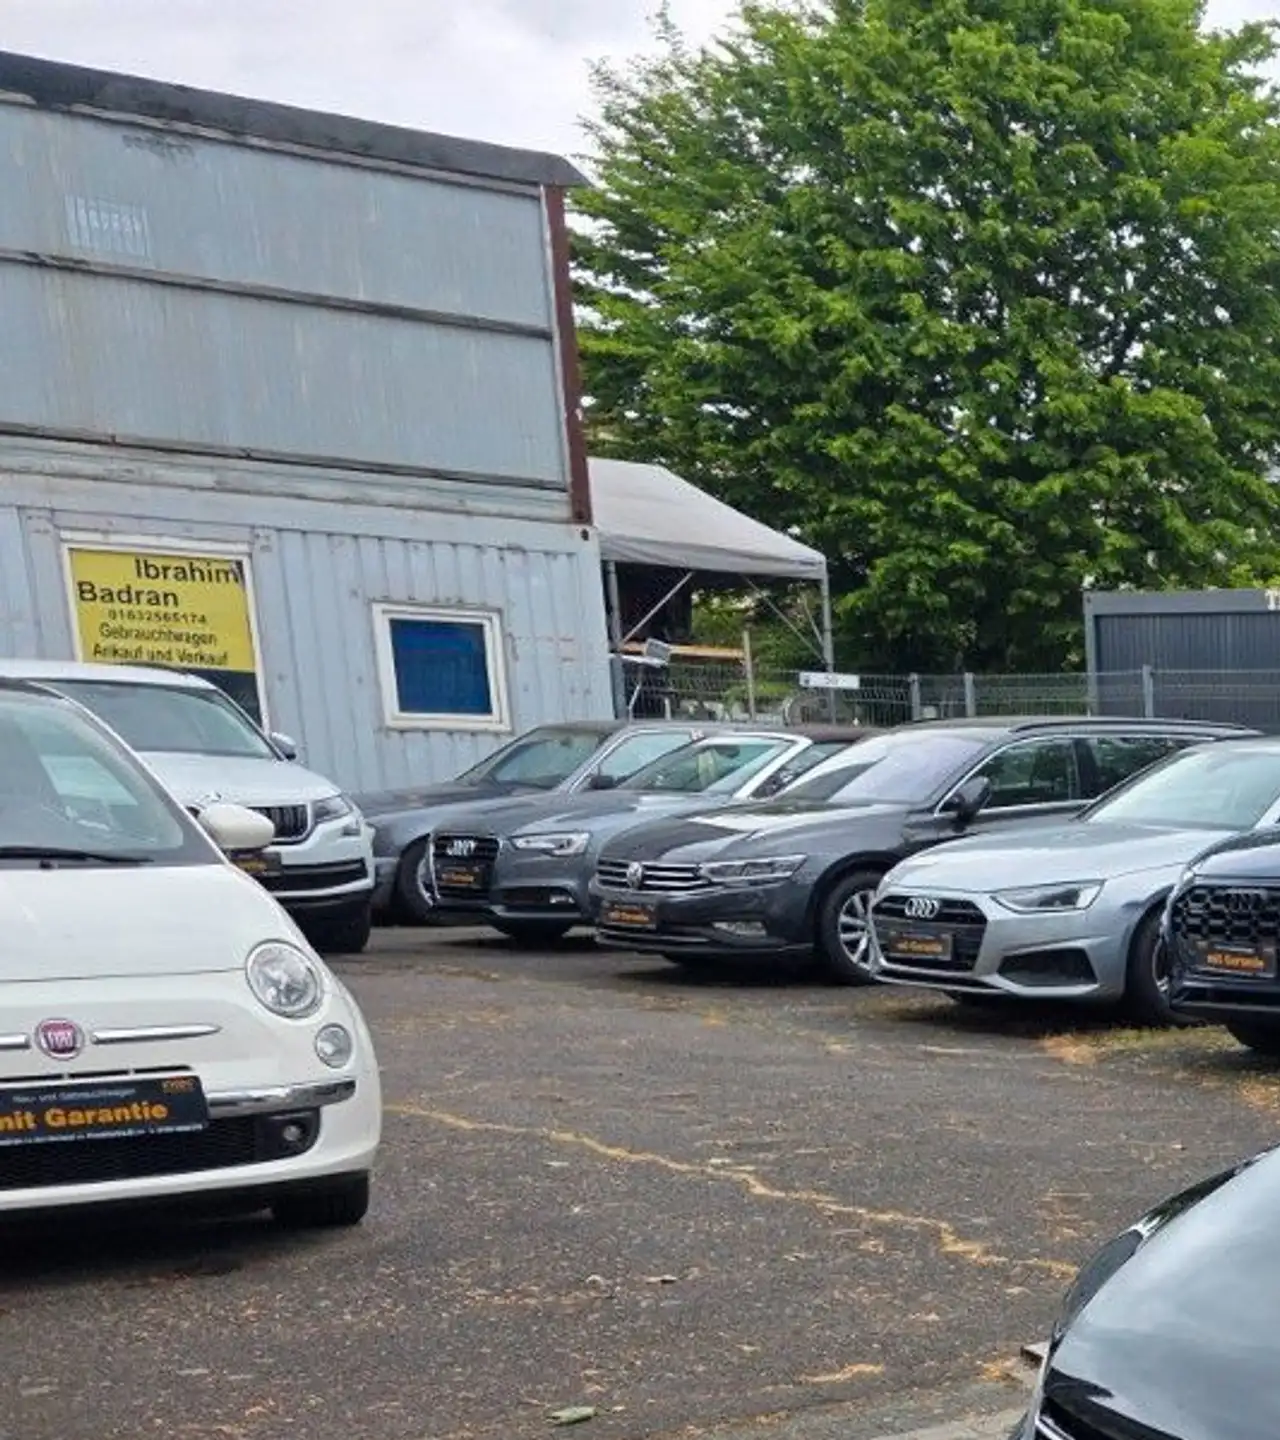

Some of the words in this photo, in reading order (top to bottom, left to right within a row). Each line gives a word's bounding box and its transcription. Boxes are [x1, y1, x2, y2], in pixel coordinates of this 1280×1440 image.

[135, 557, 242, 584] Ibrahim
[77, 581, 179, 607] Badran
[99, 622, 218, 646] Gebrauchtwagen
[93, 643, 143, 660] Ankauf
[147, 645, 173, 662] und
[174, 649, 229, 666] Verkauf
[44, 1101, 168, 1127] Garantie
